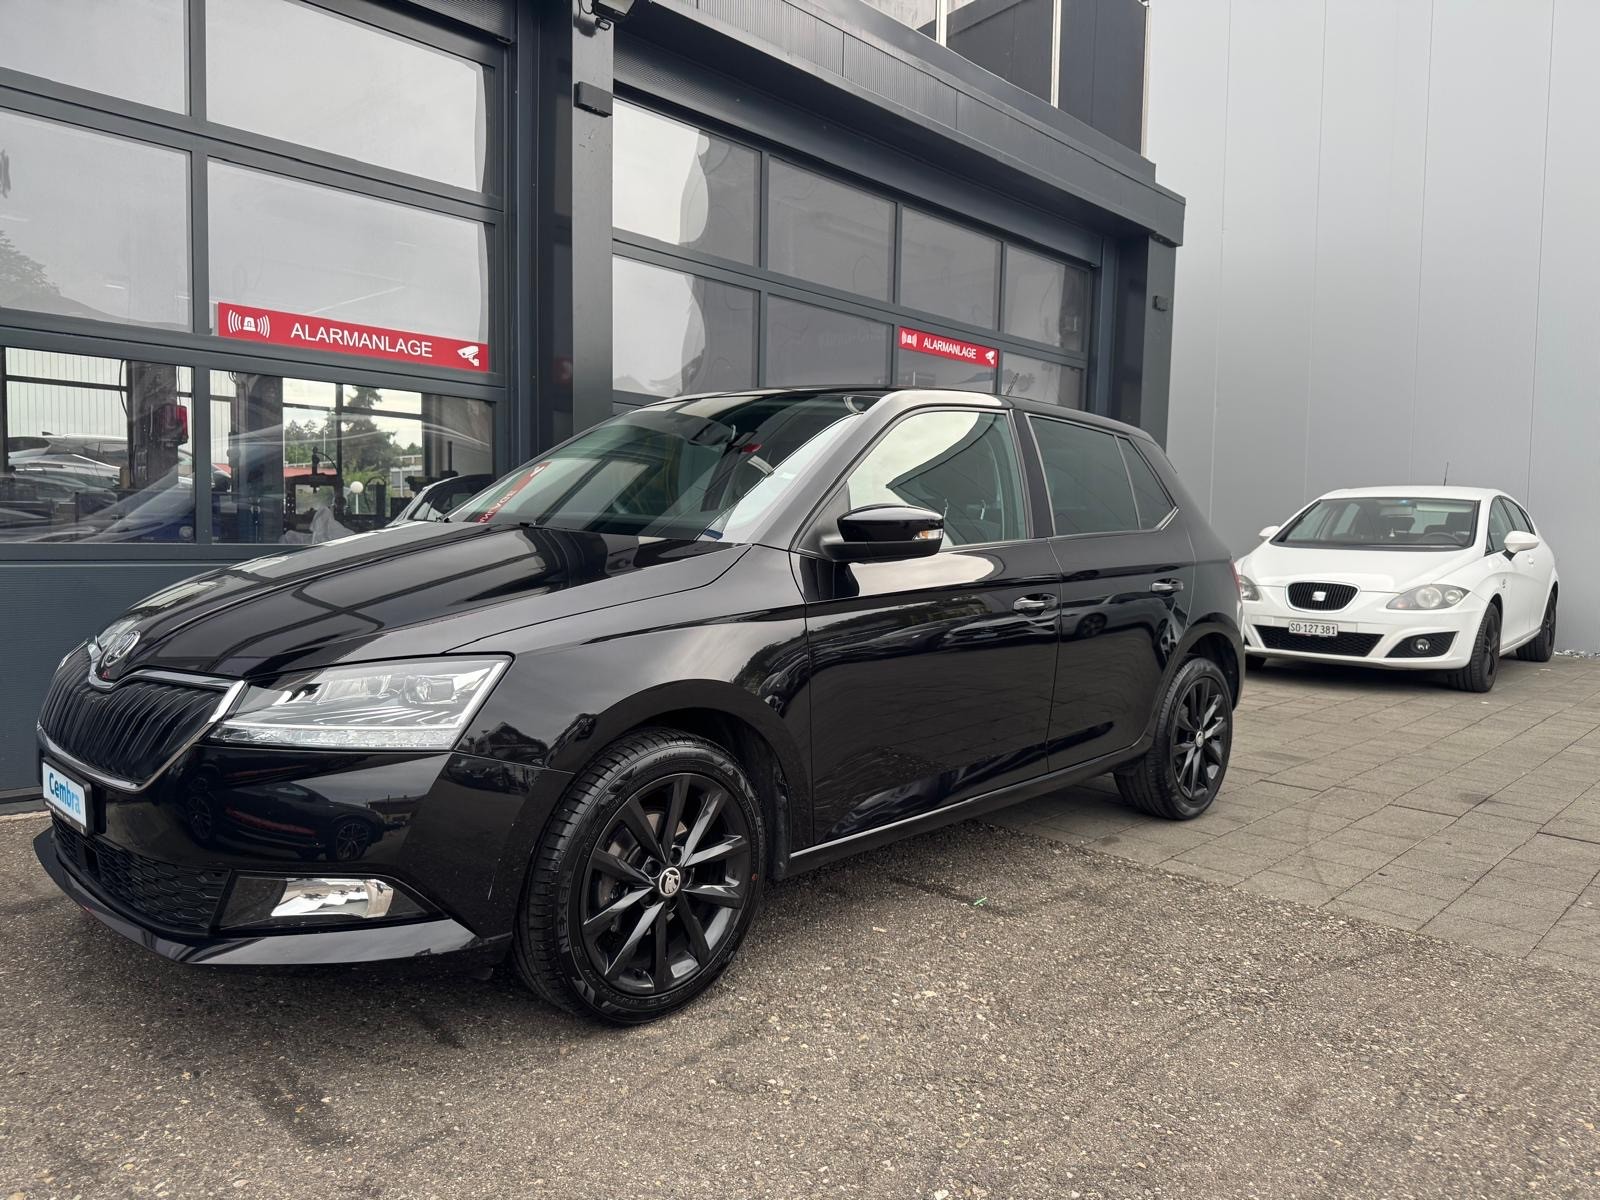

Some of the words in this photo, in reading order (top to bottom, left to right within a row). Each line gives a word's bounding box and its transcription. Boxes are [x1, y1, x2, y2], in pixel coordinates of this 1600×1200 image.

[290, 322, 433, 358] ALARMANLAGE
[923, 337, 977, 359] ALARMANLAGE
[49, 772, 81, 815] Cembra
